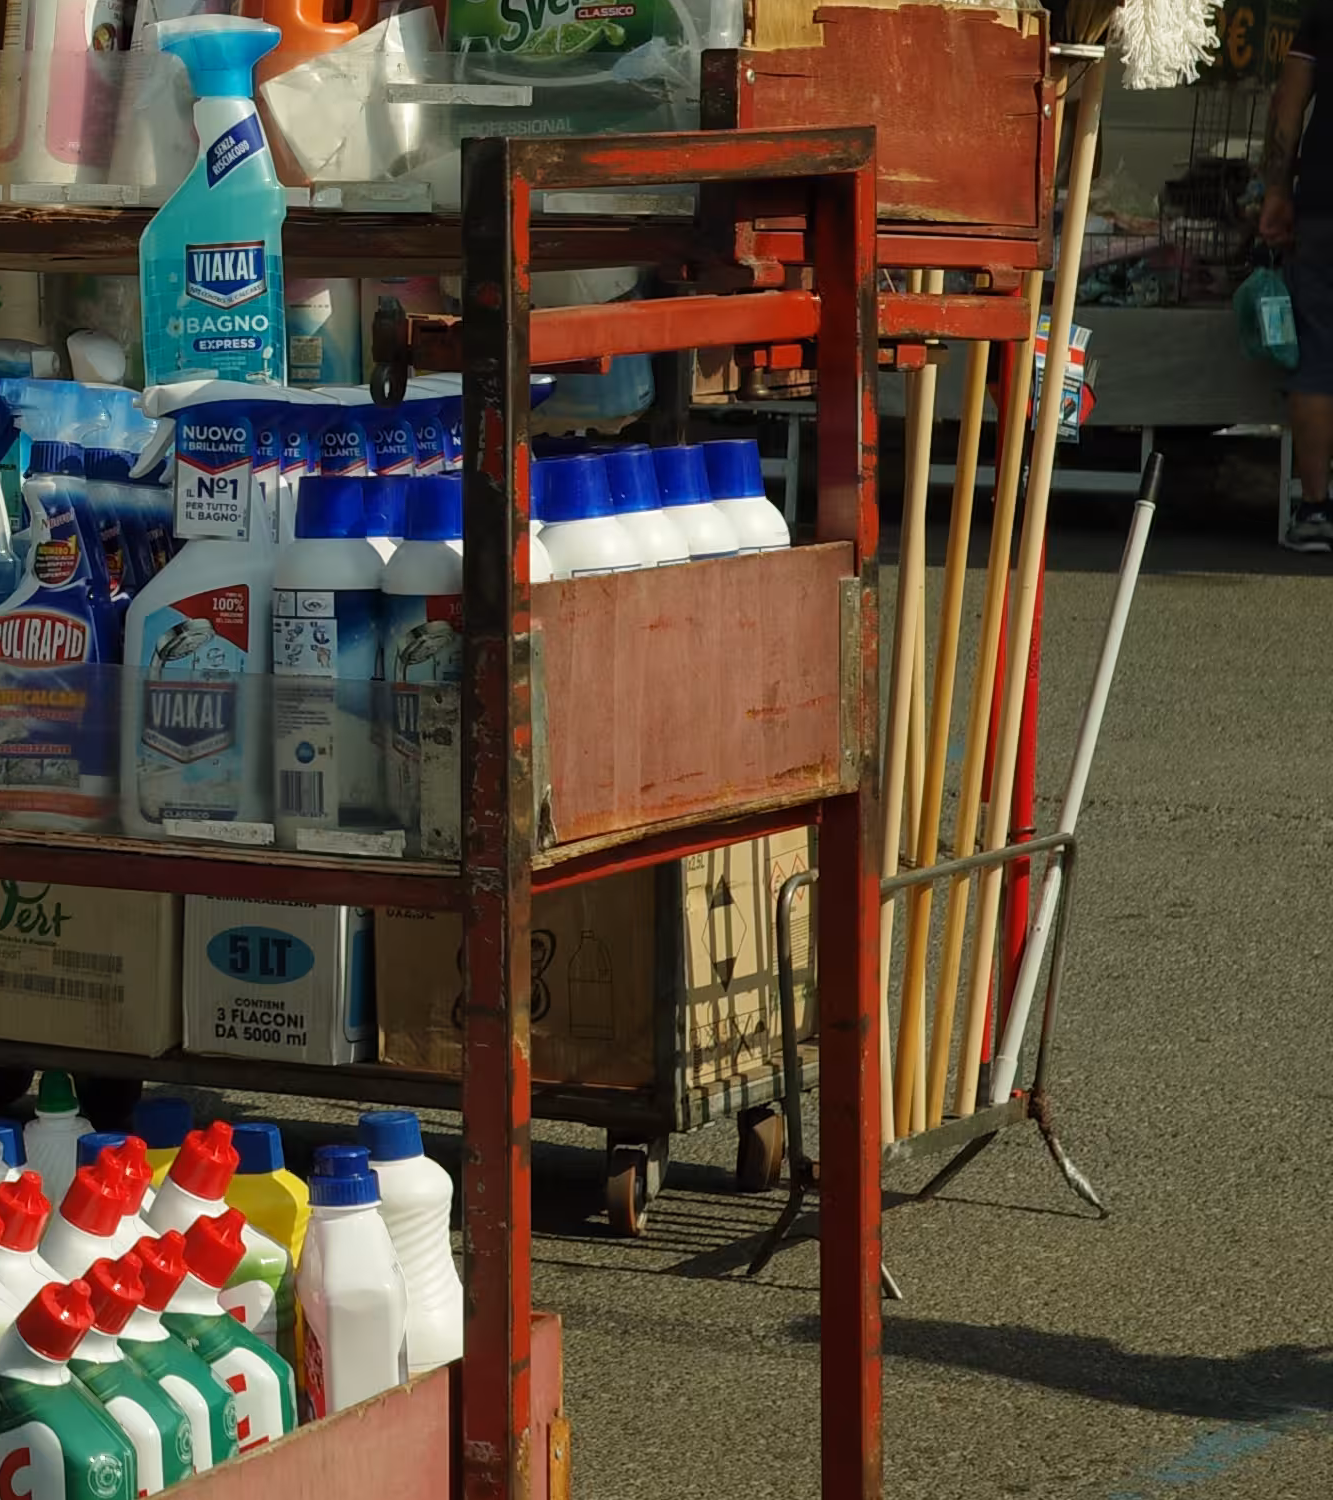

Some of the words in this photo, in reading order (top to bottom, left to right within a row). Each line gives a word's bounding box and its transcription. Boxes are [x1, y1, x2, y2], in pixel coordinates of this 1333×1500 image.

[576, 4, 635, 19] CLASSICO
[213, 135, 237, 158] SENZA
[212, 139, 251, 176] RISCIACQUO
[193, 249, 259, 284] VIAKAL
[185, 313, 270, 335] BAGNO
[198, 337, 258, 352] EXPRESS
[181, 423, 248, 443] NUOVO
[189, 439, 247, 455] BRILLANTE
[186, 487, 195, 498] IL
[185, 500, 208, 512] PER
[209, 502, 238, 513] TUTTO
[185, 510, 195, 521] IL
[212, 596, 247, 613] 100%
[150, 691, 226, 731] VIAKAL
[228, 934, 250, 974] 5
[258, 935, 292, 977] LT
[234, 996, 285, 1010] CONTIENE
[217, 1007, 226, 1023] 3
[230, 1008, 305, 1029] FLACONI
[215, 1023, 239, 1041] DA
[243, 1025, 281, 1043] 5000
[286, 1028, 307, 1046] ml
